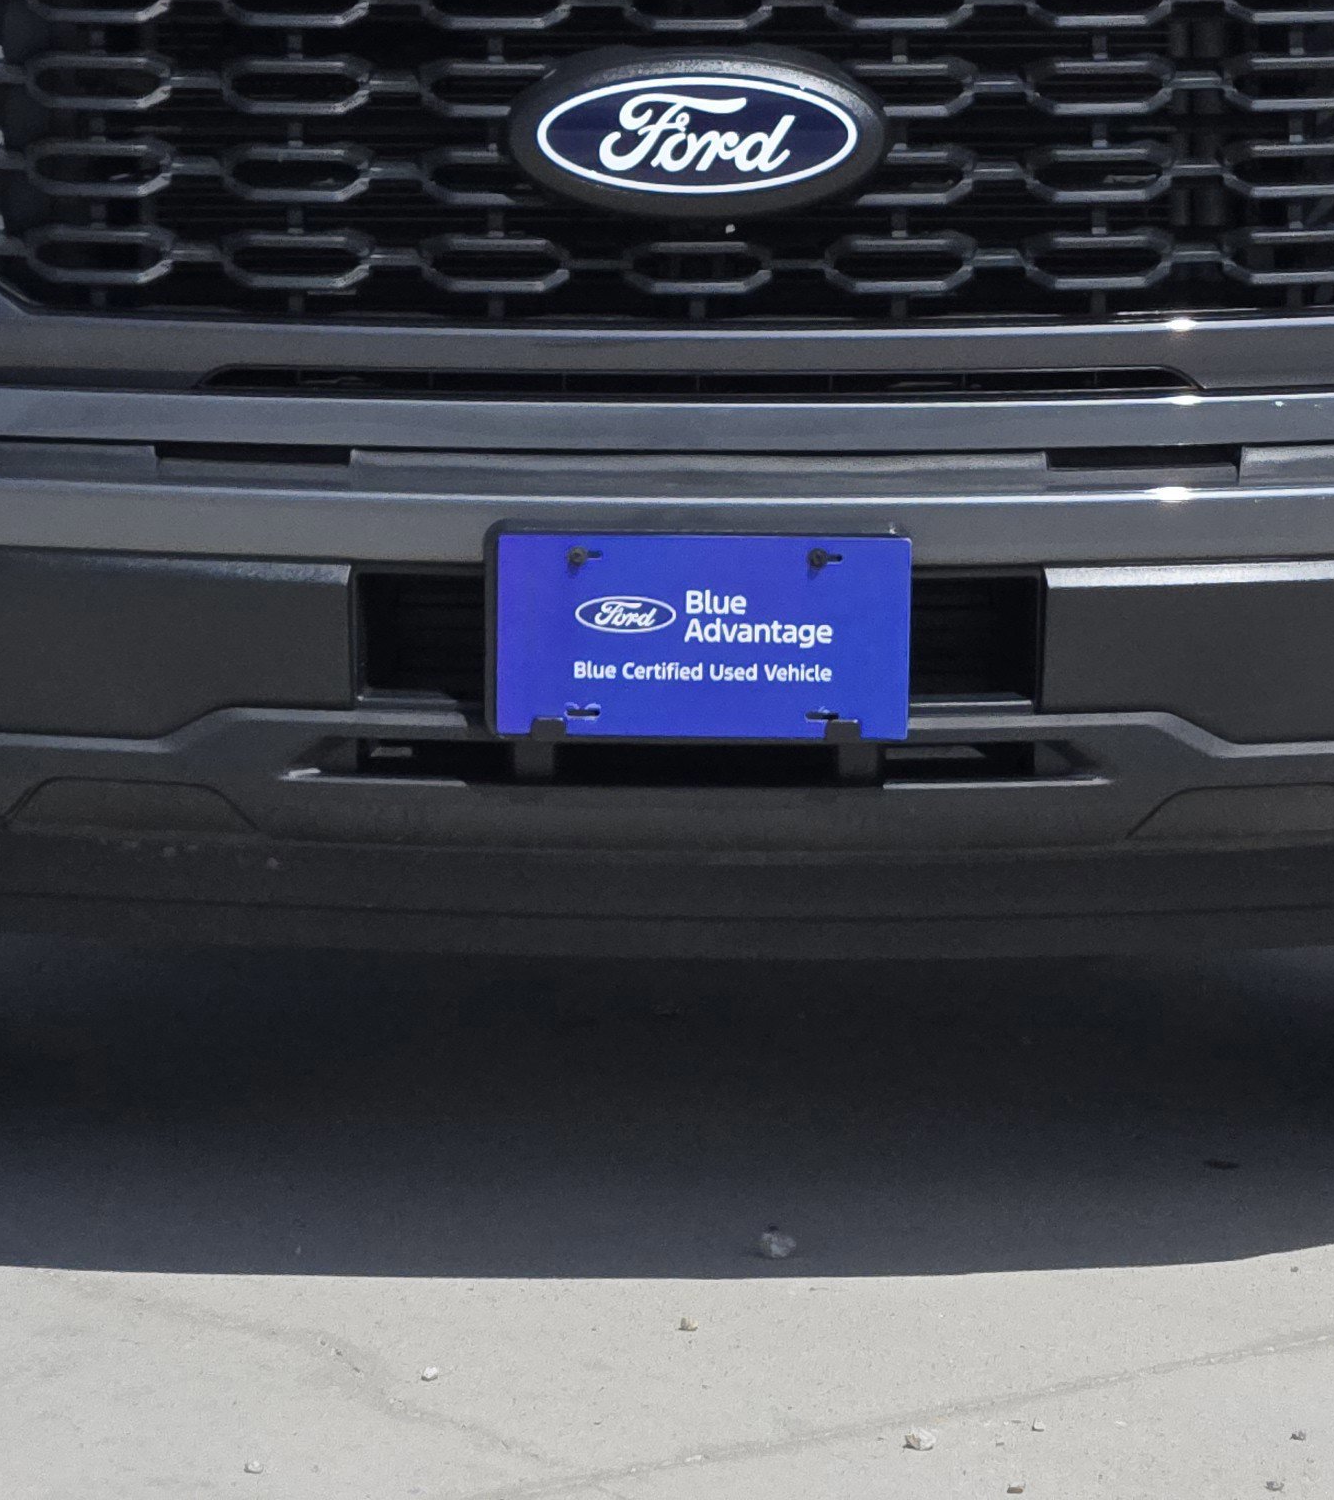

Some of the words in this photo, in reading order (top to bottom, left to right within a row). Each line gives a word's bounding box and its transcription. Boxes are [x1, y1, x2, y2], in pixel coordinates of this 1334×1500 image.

[599, 93, 796, 173] Ford
[593, 601, 657, 628] Ford
[685, 589, 747, 615] Blue
[684, 618, 833, 649] Advantage
[573, 660, 617, 680] Blue
[622, 660, 704, 682] Certified
[710, 662, 759, 682] Used
[764, 662, 833, 683] Vehicle
